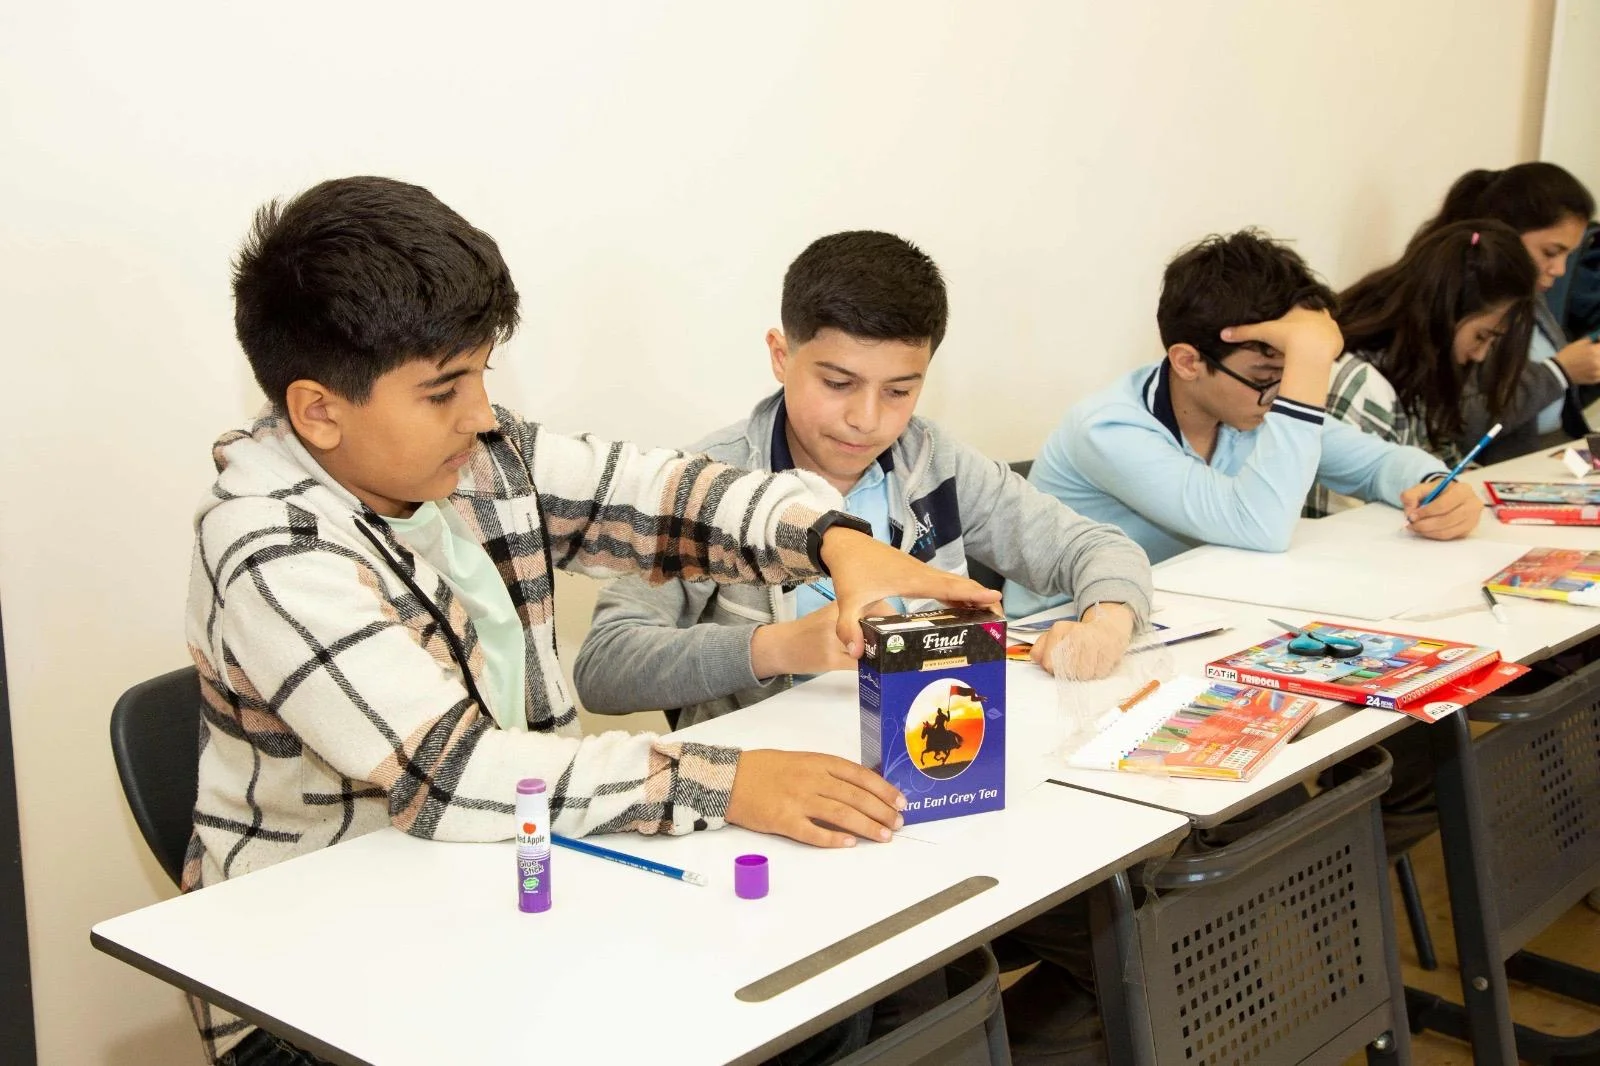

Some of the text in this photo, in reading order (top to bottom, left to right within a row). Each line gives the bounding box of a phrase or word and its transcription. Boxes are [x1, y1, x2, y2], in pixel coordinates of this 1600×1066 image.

[922, 629, 968, 649] Final
[1366, 695, 1381, 707] 24
[924, 795, 947, 809] Earl
[949, 792, 976, 804] Grey
[979, 788, 998, 800] Tea
[528, 835, 545, 845] Apple
[524, 865, 544, 876] Stick
